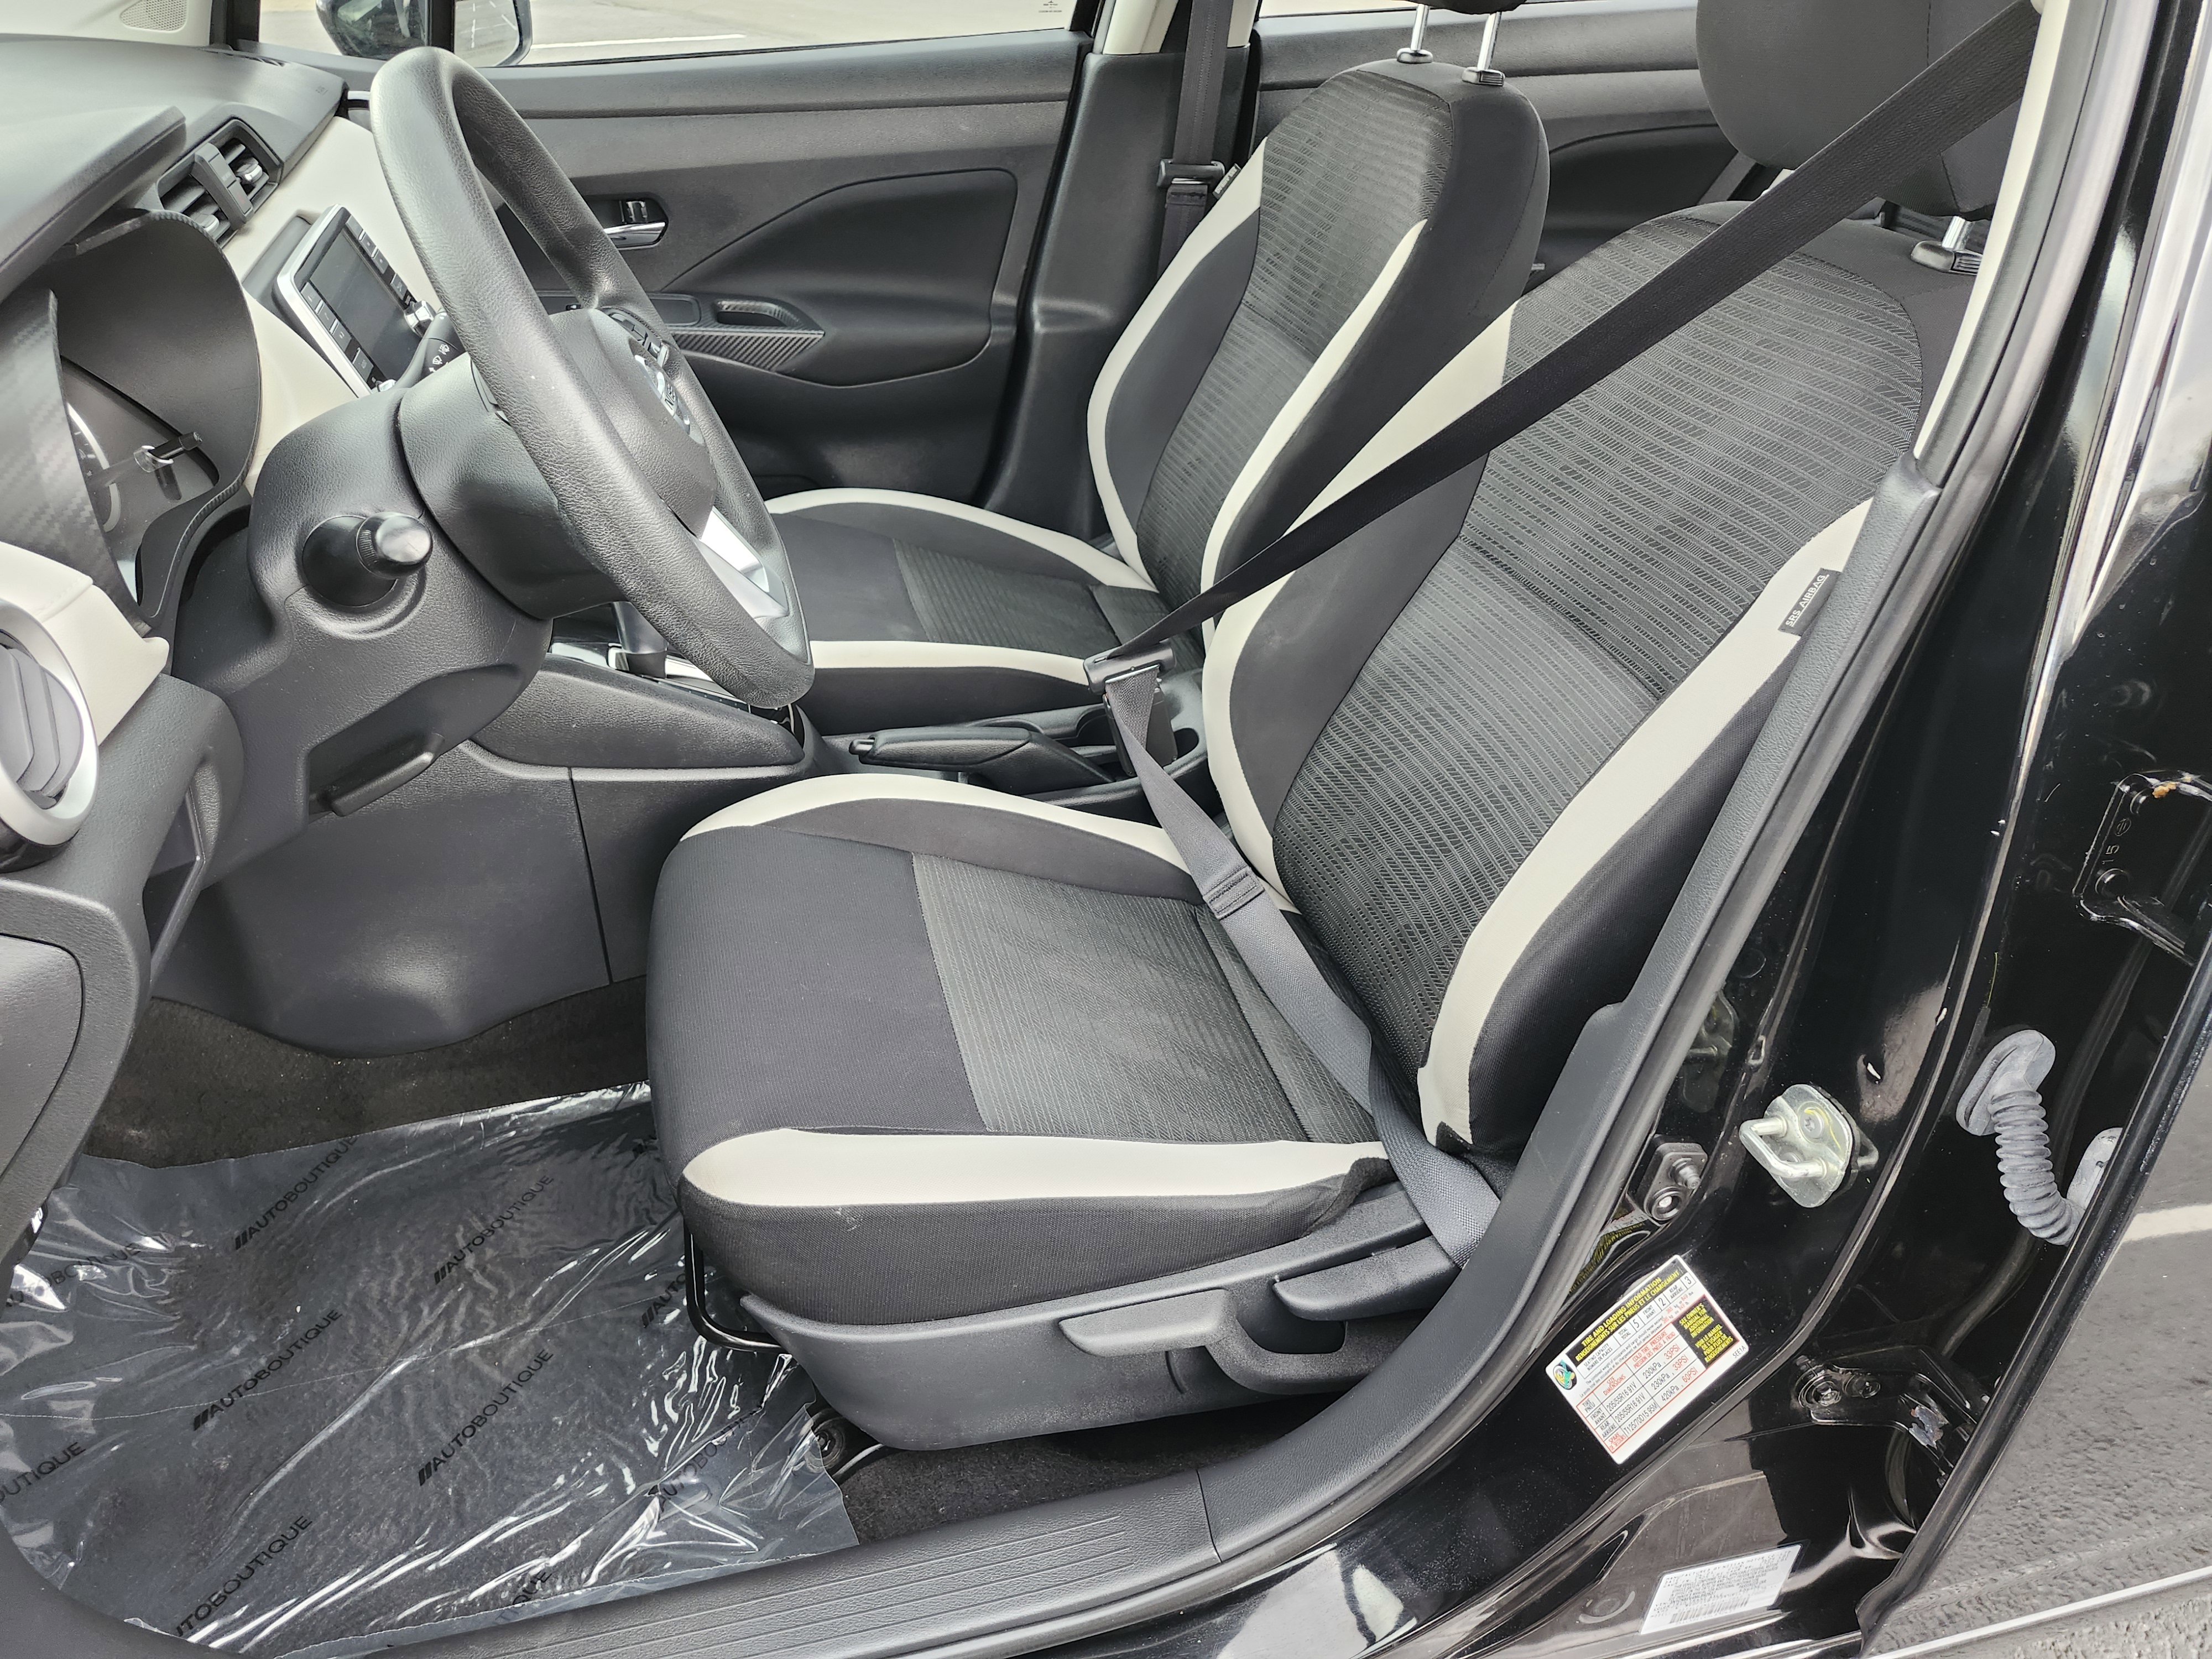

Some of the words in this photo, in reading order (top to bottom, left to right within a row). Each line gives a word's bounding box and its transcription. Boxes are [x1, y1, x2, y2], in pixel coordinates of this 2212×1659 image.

[1786, 609, 1801, 626] SRS
[1799, 575, 1826, 608] AIRBAG
[446, 1175, 554, 1273] AUTOBOUTIQUE
[1684, 1276, 1692, 1284] 3
[1581, 1334, 1593, 1347] TIRE
[1592, 1324, 1605, 1337] AND
[1603, 1306, 1626, 1327] LOADING
[1625, 1276, 1661, 1308] INFORMATION
[1658, 1297, 1665, 1306] 2
[1575, 1329, 1610, 1361] RENSEIGNEMENTS
[1608, 1321, 1618, 1332] SUR
[1616, 1315, 1626, 1324] LES
[1624, 1303, 1640, 1318] PNEUS
[1650, 1269, 1679, 1297] CHARGEMENT
[1632, 1319, 1640, 1328] 5
[1732, 1345, 1745, 1358] SEE1A
[211, 1310, 343, 1418] AUTOBOUTIQUE
[1606, 1376, 1615, 1385] SIZE
[1606, 1389, 1629, 1411] 205/55R16
[1626, 1381, 1637, 1392] 91V
[432, 1349, 554, 1472] AUTOBOUTIQUE
[1585, 1402, 1595, 1412] PNEU
[1590, 1408, 1602, 1420] FRONT
[1615, 1400, 1637, 1422] 205/55R16
[1635, 1392, 1645, 1404] 91V
[1594, 1413, 1606, 1425] AVANT
[1600, 1421, 1609, 1430] REAR
[1624, 1410, 1649, 1434] T125/70D15
[1646, 1402, 1658, 1413] 95M
